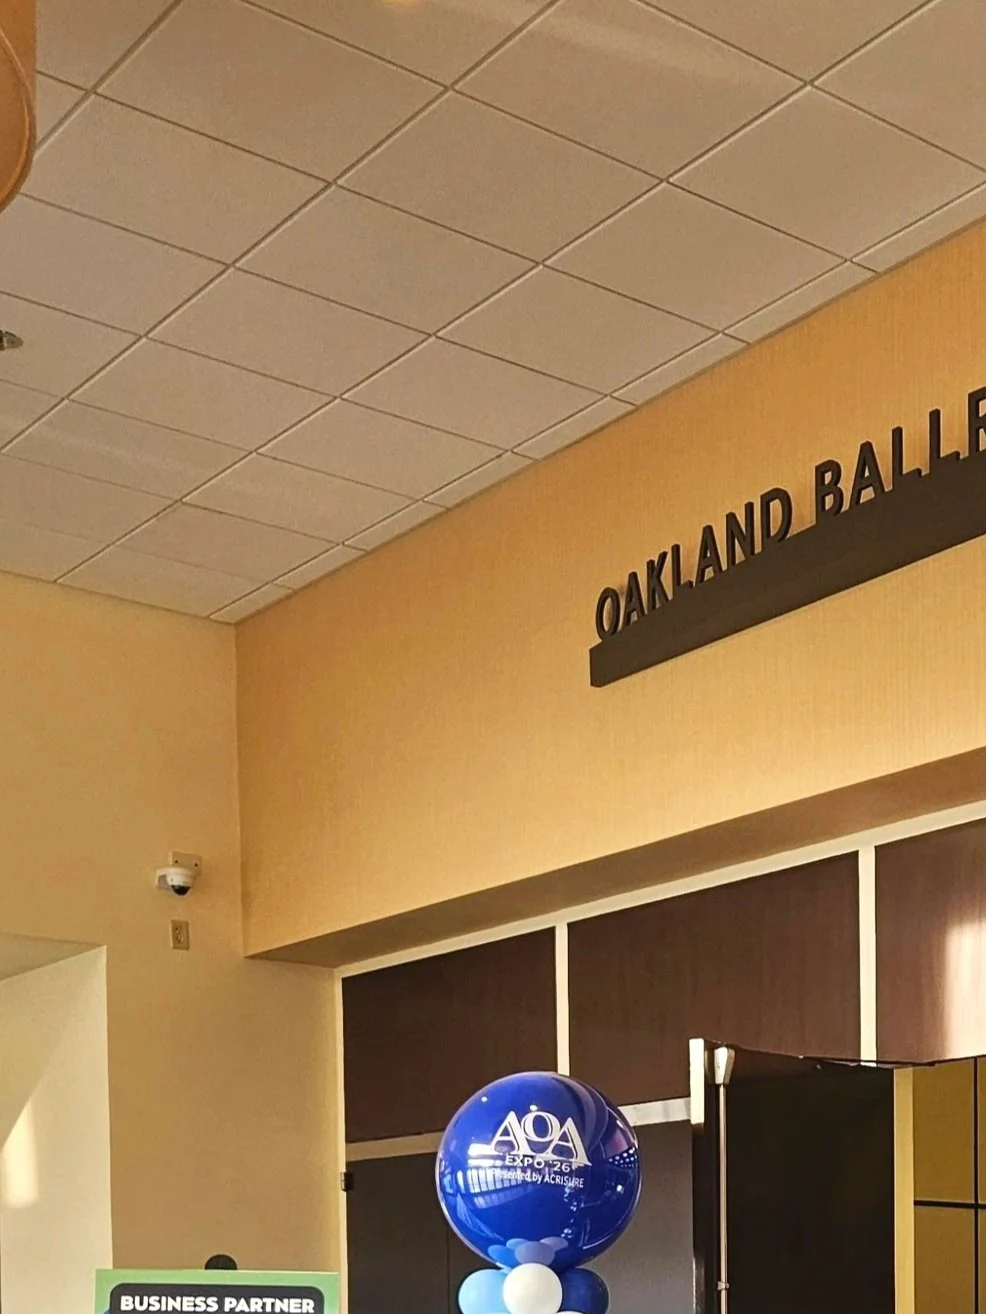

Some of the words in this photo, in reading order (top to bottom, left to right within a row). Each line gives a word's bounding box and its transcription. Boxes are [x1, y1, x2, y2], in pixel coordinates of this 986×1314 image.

[594, 486, 793, 641] OAKLAND
[488, 1110, 592, 1166] AOA
[505, 1154, 545, 1169] EXPO
[532, 1171, 543, 1184] by
[544, 1173, 585, 1189] ACRISURE
[120, 1295, 219, 1312] BUSINESS
[224, 1297, 315, 1313] PARTNER
